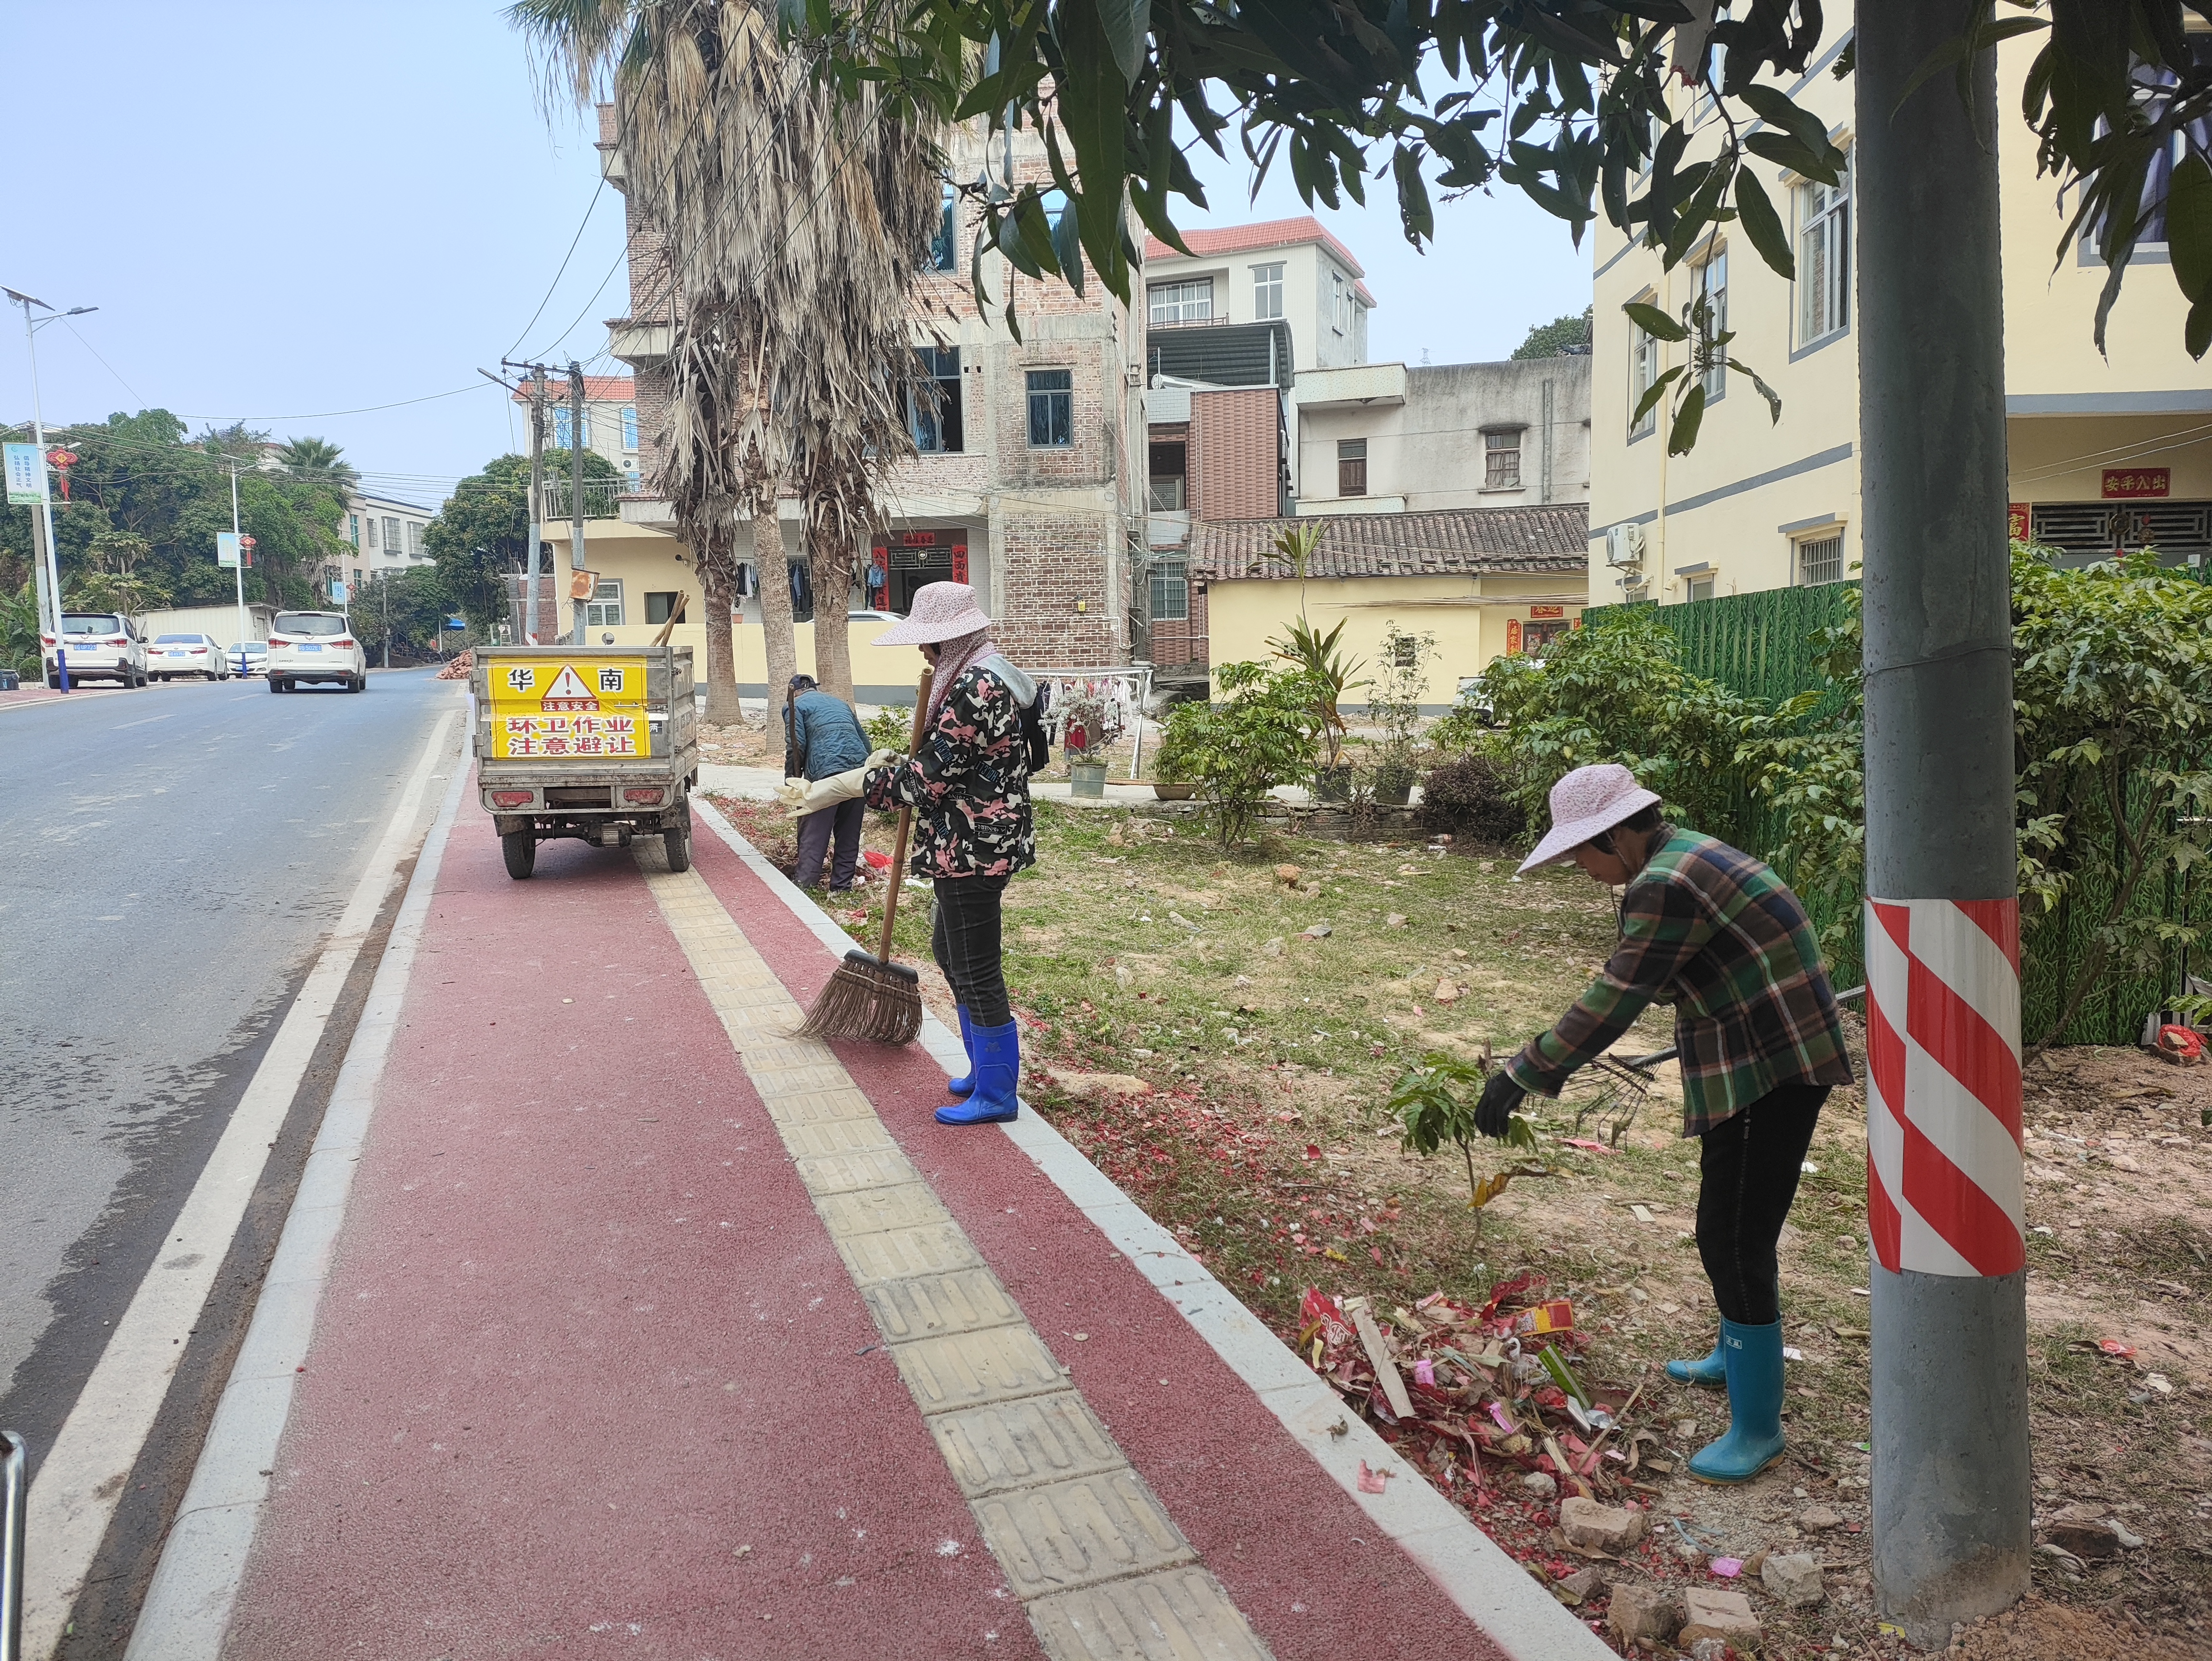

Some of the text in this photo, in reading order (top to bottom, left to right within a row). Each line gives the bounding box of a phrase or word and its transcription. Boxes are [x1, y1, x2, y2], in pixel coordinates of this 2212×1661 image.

[13, 455, 22, 488] 弘扬社会正气
[23, 455, 32, 488] 倡导精神文明
[508, 668, 623, 691] 华 南
[542, 701, 598, 711] 注意安全
[508, 716, 634, 734] 环卫作业
[509, 737, 635, 755] 注意避让
